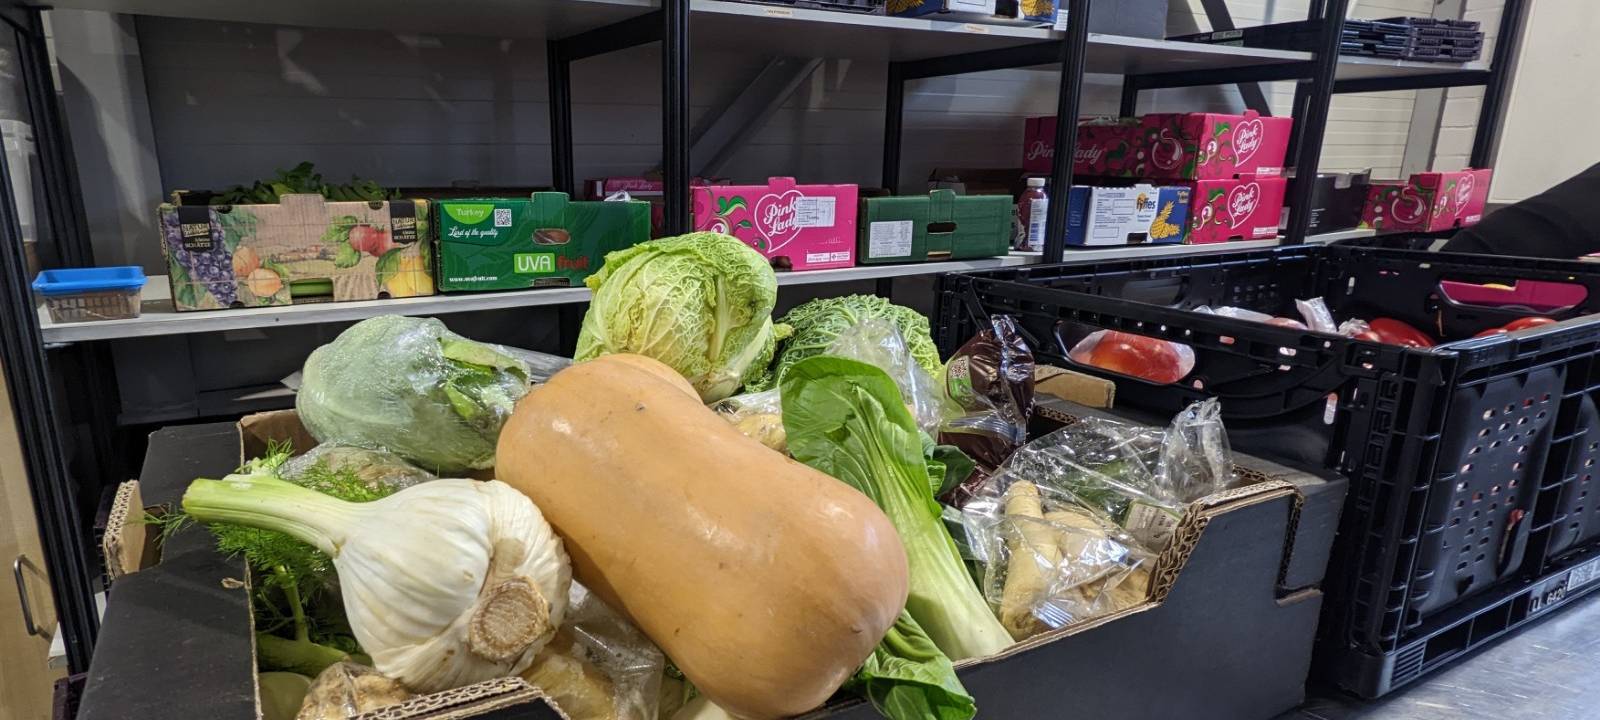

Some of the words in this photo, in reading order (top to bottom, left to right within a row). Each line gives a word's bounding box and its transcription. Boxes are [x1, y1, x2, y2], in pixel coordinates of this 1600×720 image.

[1236, 124, 1258, 145] Pink
[1027, 141, 1056, 160] Pin
[1237, 136, 1258, 154] Lady
[1232, 187, 1255, 208] Pink
[456, 207, 485, 218] Turkey
[763, 196, 797, 225] Pink
[1232, 199, 1256, 217] Lady
[480, 227, 498, 239] quality
[767, 212, 799, 237] Lady
[518, 255, 552, 272] UVA
[557, 255, 589, 271] fruit
